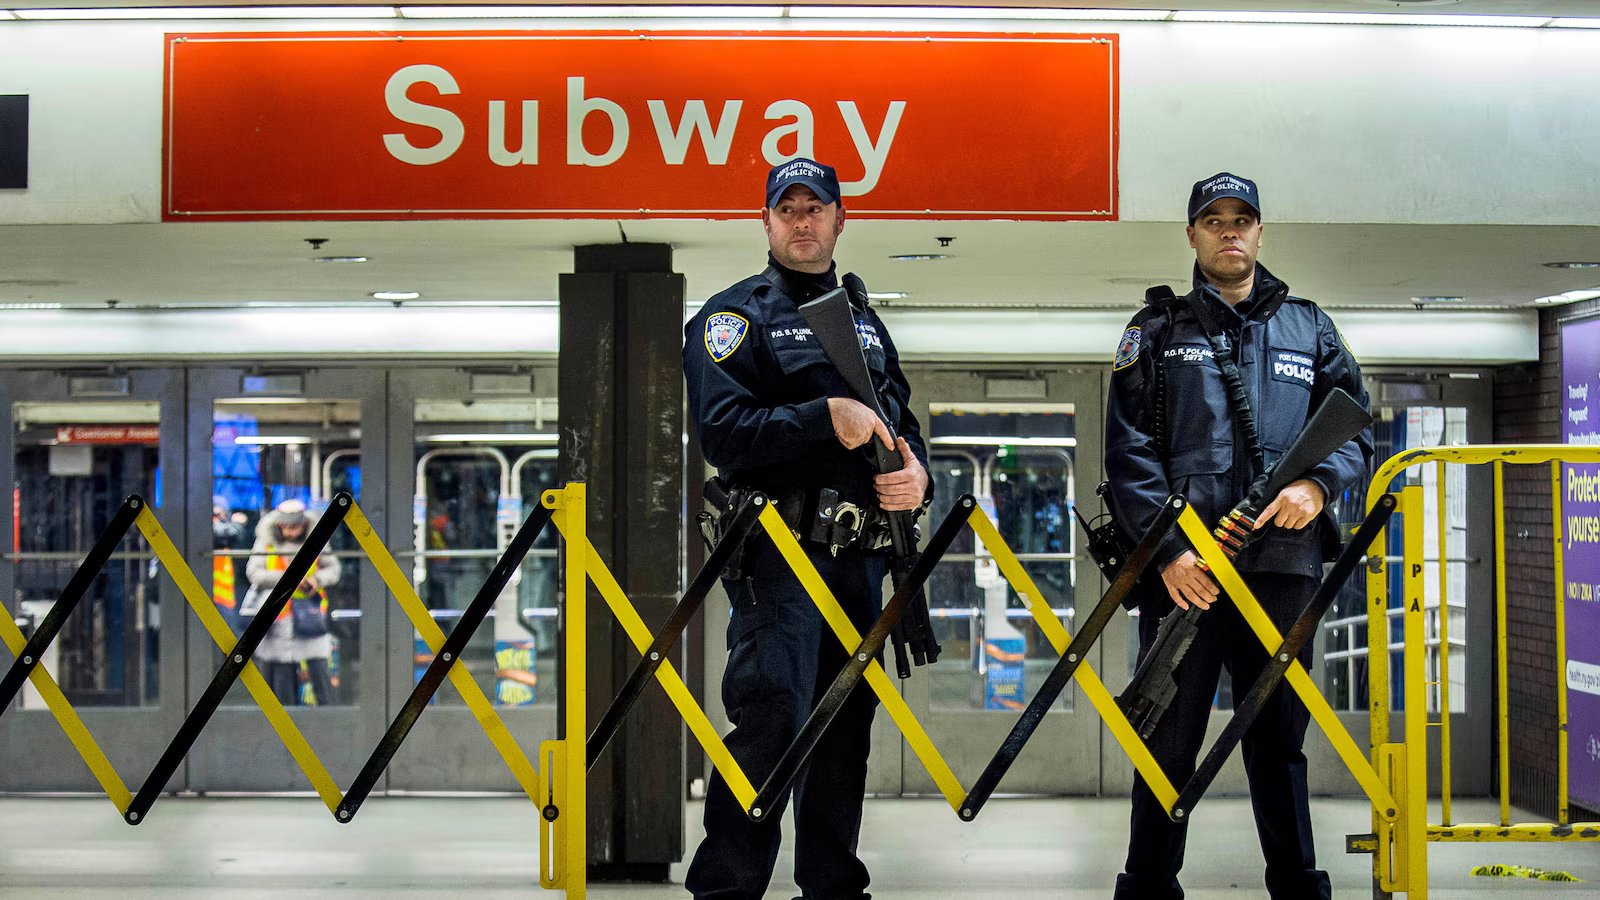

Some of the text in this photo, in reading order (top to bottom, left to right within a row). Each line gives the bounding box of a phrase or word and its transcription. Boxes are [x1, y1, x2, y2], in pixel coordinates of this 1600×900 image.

[382, 64, 907, 196] Subway
[776, 162, 825, 183] PORT AUTHORITY
[785, 168, 813, 179] POLICE
[1202, 176, 1250, 195] PORT AUTHORITY
[1212, 182, 1240, 192] POLICE
[710, 318, 741, 331] POLICE
[1164, 350, 1177, 358] P.O.
[1567, 467, 1600, 503] Protect
